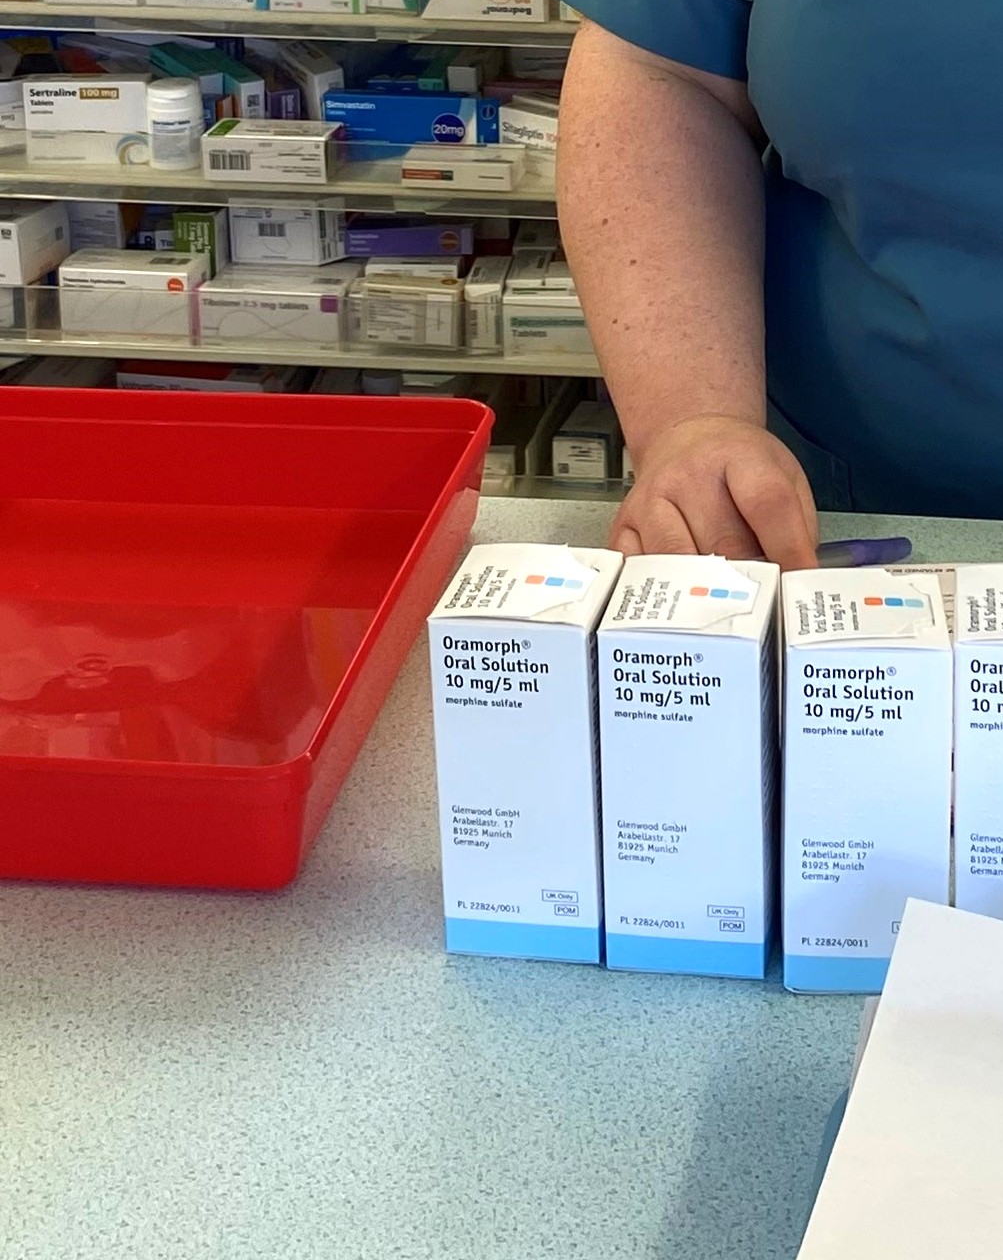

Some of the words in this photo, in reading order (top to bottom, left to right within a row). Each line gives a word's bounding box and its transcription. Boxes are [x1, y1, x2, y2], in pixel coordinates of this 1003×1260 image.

[29, 88, 77, 98] Sertraline
[82, 88, 98, 97] 100
[100, 89, 118, 99] mg
[326, 100, 376, 110] Simvastatin
[433, 124, 465, 136] 20mg
[443, 636, 531, 655] Oramorph®
[444, 656, 476, 671] Oral
[481, 657, 549, 674] Solution
[613, 648, 704, 667] Oramorph®
[614, 668, 646, 684] Oral
[652, 670, 721, 688] Solution
[803, 664, 897, 682] Oramorph®
[446, 673, 464, 688] 10
[470, 676, 512, 693] mg/5
[519, 679, 539, 693] ml
[615, 688, 633, 702] 10
[640, 690, 684, 707] mg/5
[690, 692, 710, 706] ml
[803, 684, 837, 700] Oral
[843, 685, 914, 702] Solution
[446, 697, 489, 709] morphine
[491, 698, 522, 709] sulfate
[971, 698, 990, 713] 10
[614, 710, 658, 722] morphine
[661, 713, 693, 723] sulfate
[804, 703, 823, 718] 10
[830, 704, 874, 722] mg/5
[882, 705, 903, 721] ml
[803, 727, 848, 738] morphine
[851, 726, 884, 738] sulfate
